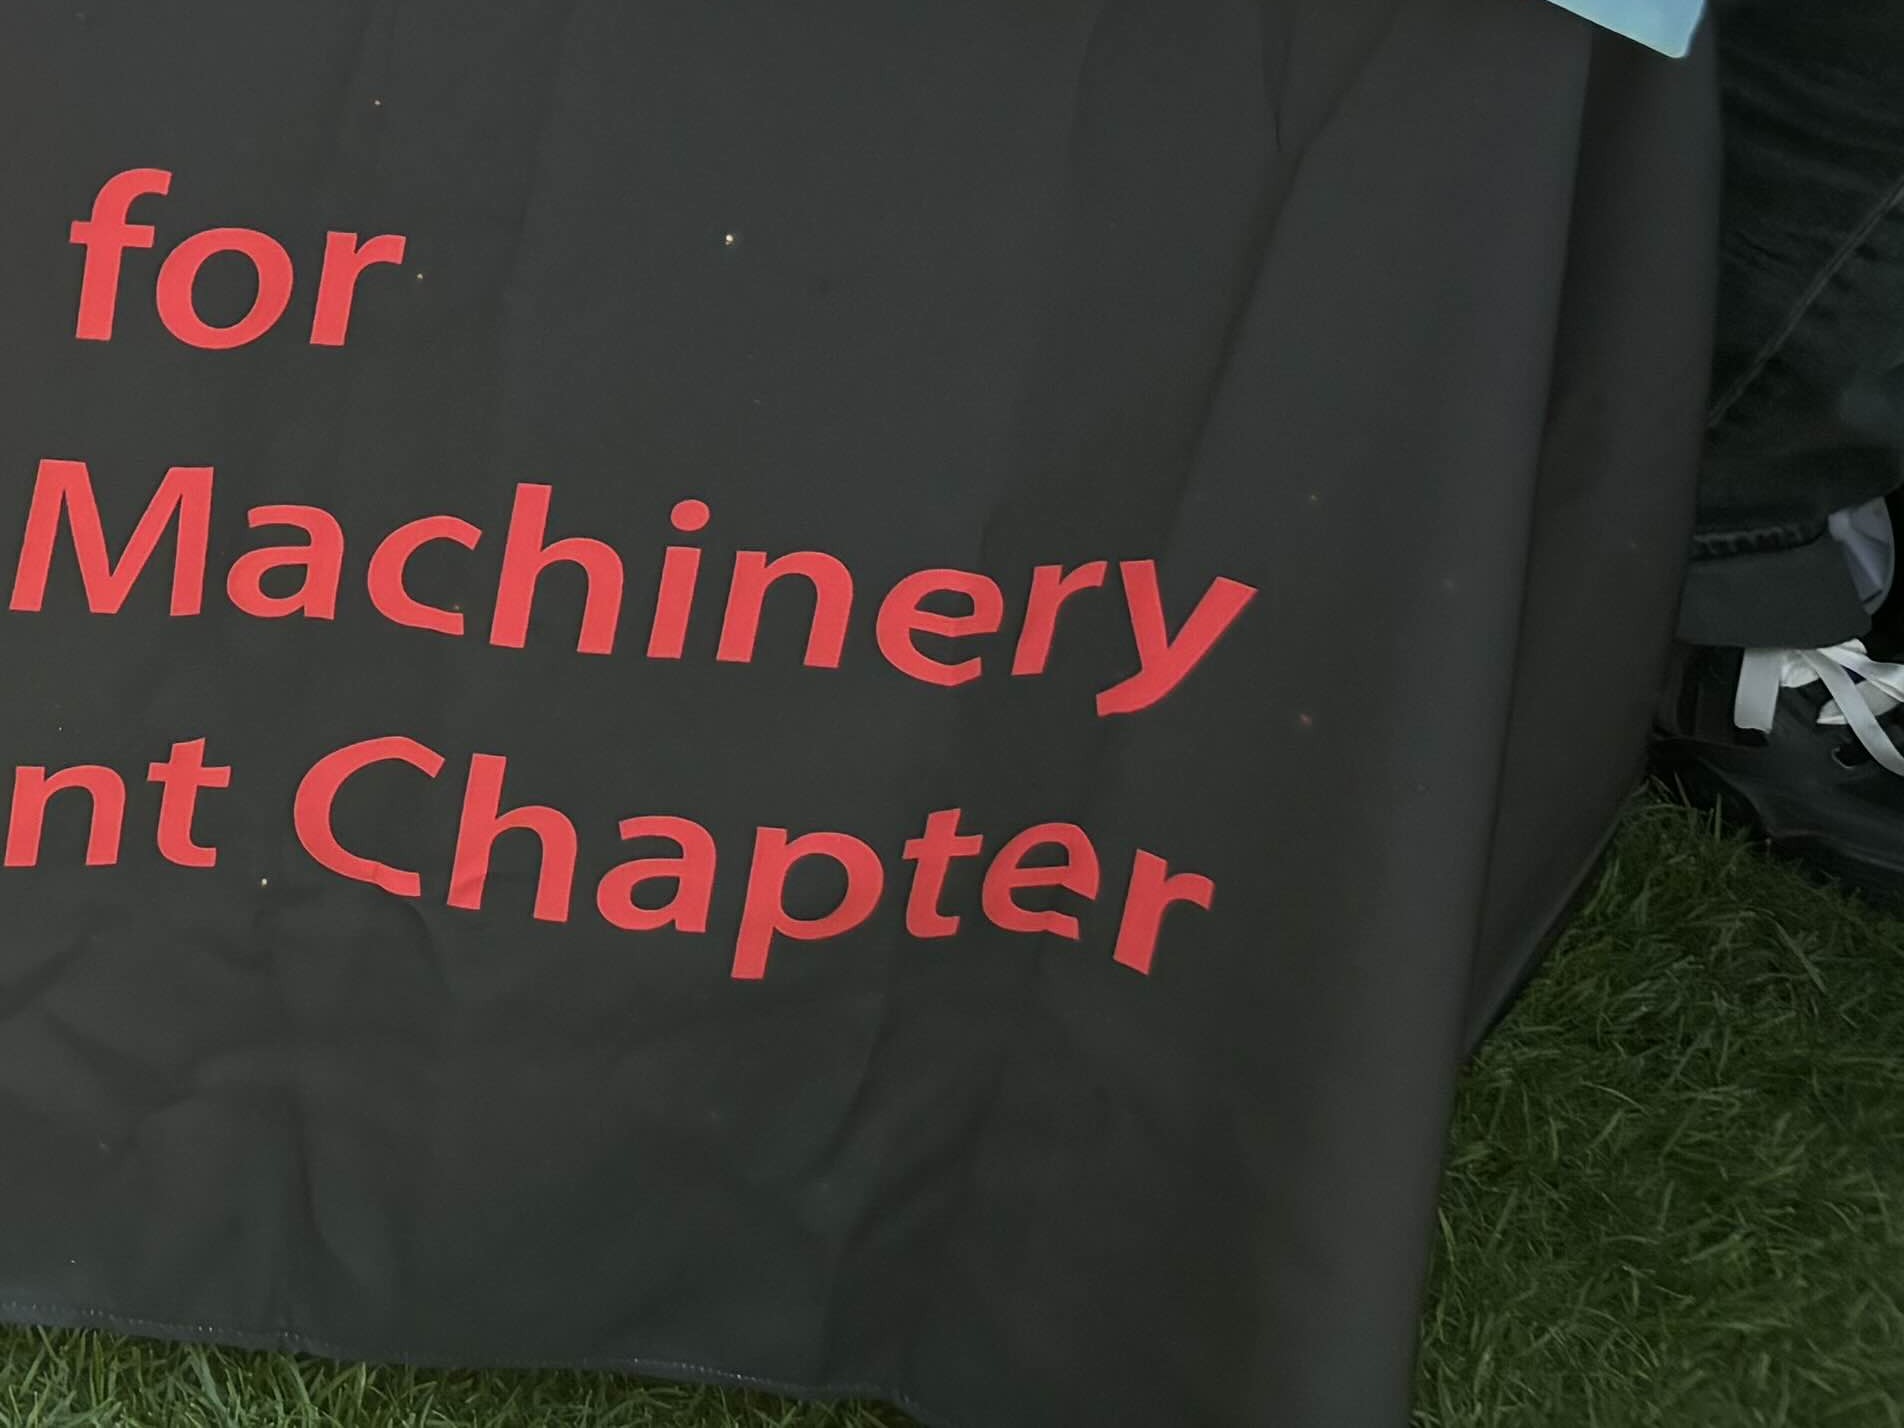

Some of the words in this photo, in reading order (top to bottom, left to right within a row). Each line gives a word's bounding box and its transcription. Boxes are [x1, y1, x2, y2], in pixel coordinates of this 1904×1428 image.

[70, 167, 408, 351] for
[10, 459, 1260, 718] Machinery
[294, 736, 1218, 982] Chapter
